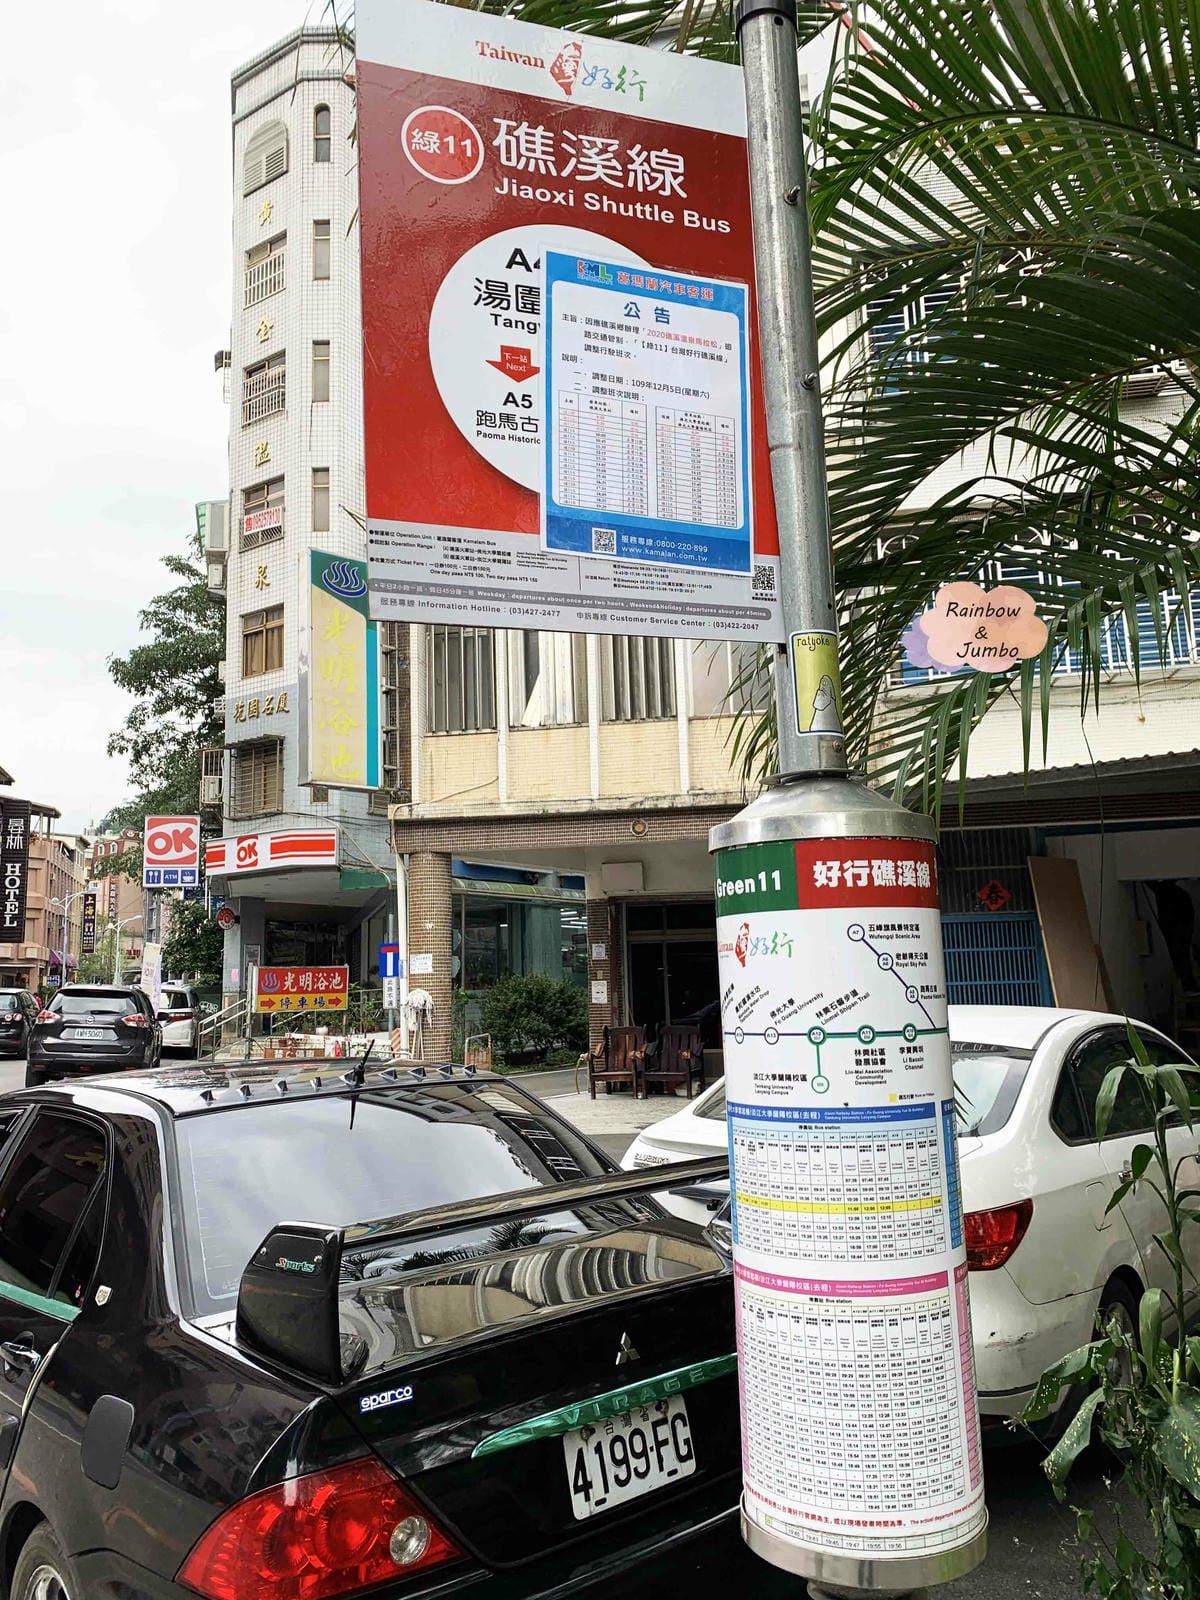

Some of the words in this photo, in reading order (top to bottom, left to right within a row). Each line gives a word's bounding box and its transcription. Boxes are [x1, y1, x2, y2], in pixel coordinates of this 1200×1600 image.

[475, 40, 546, 69] Taiwan
[410, 127, 474, 158] 綠11
[491, 117, 688, 199] 礁溪線
[494, 176, 575, 207] Jiaoxi
[583, 192, 675, 224] Shuttle
[683, 210, 731, 234] Bus
[505, 247, 541, 273] A
[489, 312, 541, 335] Tang
[623, 301, 671, 325] 公告
[503, 352, 528, 363] 下一站
[506, 362, 526, 373] Next
[502, 391, 533, 409] A5
[475, 409, 540, 434] 跑馬古
[476, 430, 506, 441] Paoma
[508, 433, 541, 445] Historic
[391, 540, 416, 548] Operation
[396, 532, 421, 540] Operation
[621, 544, 708, 562] www.kamalan.com.tw
[418, 600, 468, 611] Information
[509, 607, 561, 617] (03)427-2477
[610, 614, 648, 623] Customer
[649, 617, 678, 626] Service
[712, 621, 759, 630] (03)422-2047
[511, 593, 546, 601] departures
[686, 606, 717, 614] departures
[320, 607, 361, 779] 光明浴池
[147, 827, 197, 856] OK
[237, 841, 258, 863] OK
[716, 877, 756, 899] Green
[757, 869, 782, 892] 11
[812, 859, 931, 890] 好行礁溪線
[3, 863, 22, 927] HOTEL
[283, 972, 344, 993] 光明浴池
[279, 996, 329, 1010] 停車場
[797, 991, 824, 1011] University
[275, 1257, 316, 1273] Sports
[361, 1386, 413, 1411] sparco
[561, 1368, 705, 1425] VIRAGE
